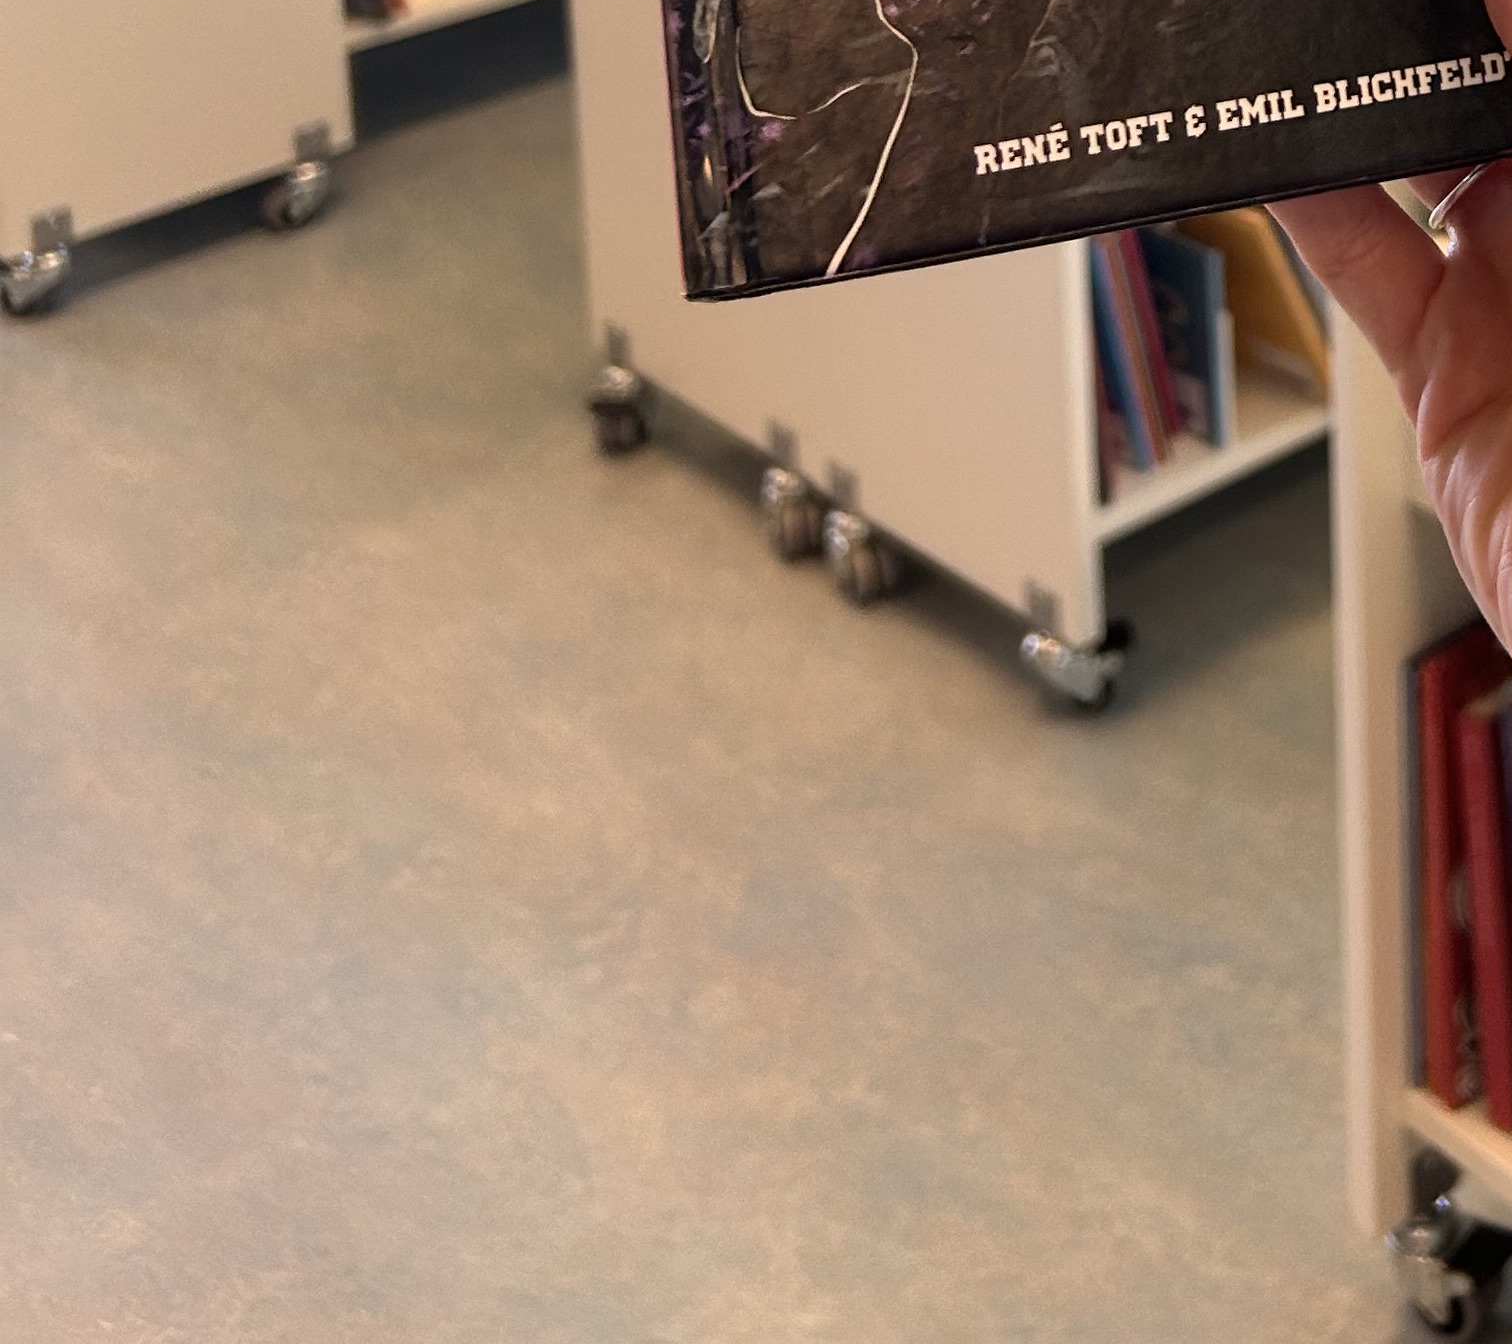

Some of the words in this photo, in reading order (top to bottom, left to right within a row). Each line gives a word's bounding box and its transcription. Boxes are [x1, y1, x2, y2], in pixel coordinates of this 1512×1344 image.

[973, 125, 1071, 175] RENÉ
[1081, 111, 1174, 155] TOFT
[1185, 105, 1207, 137] &
[1217, 89, 1304, 132] EMIL
